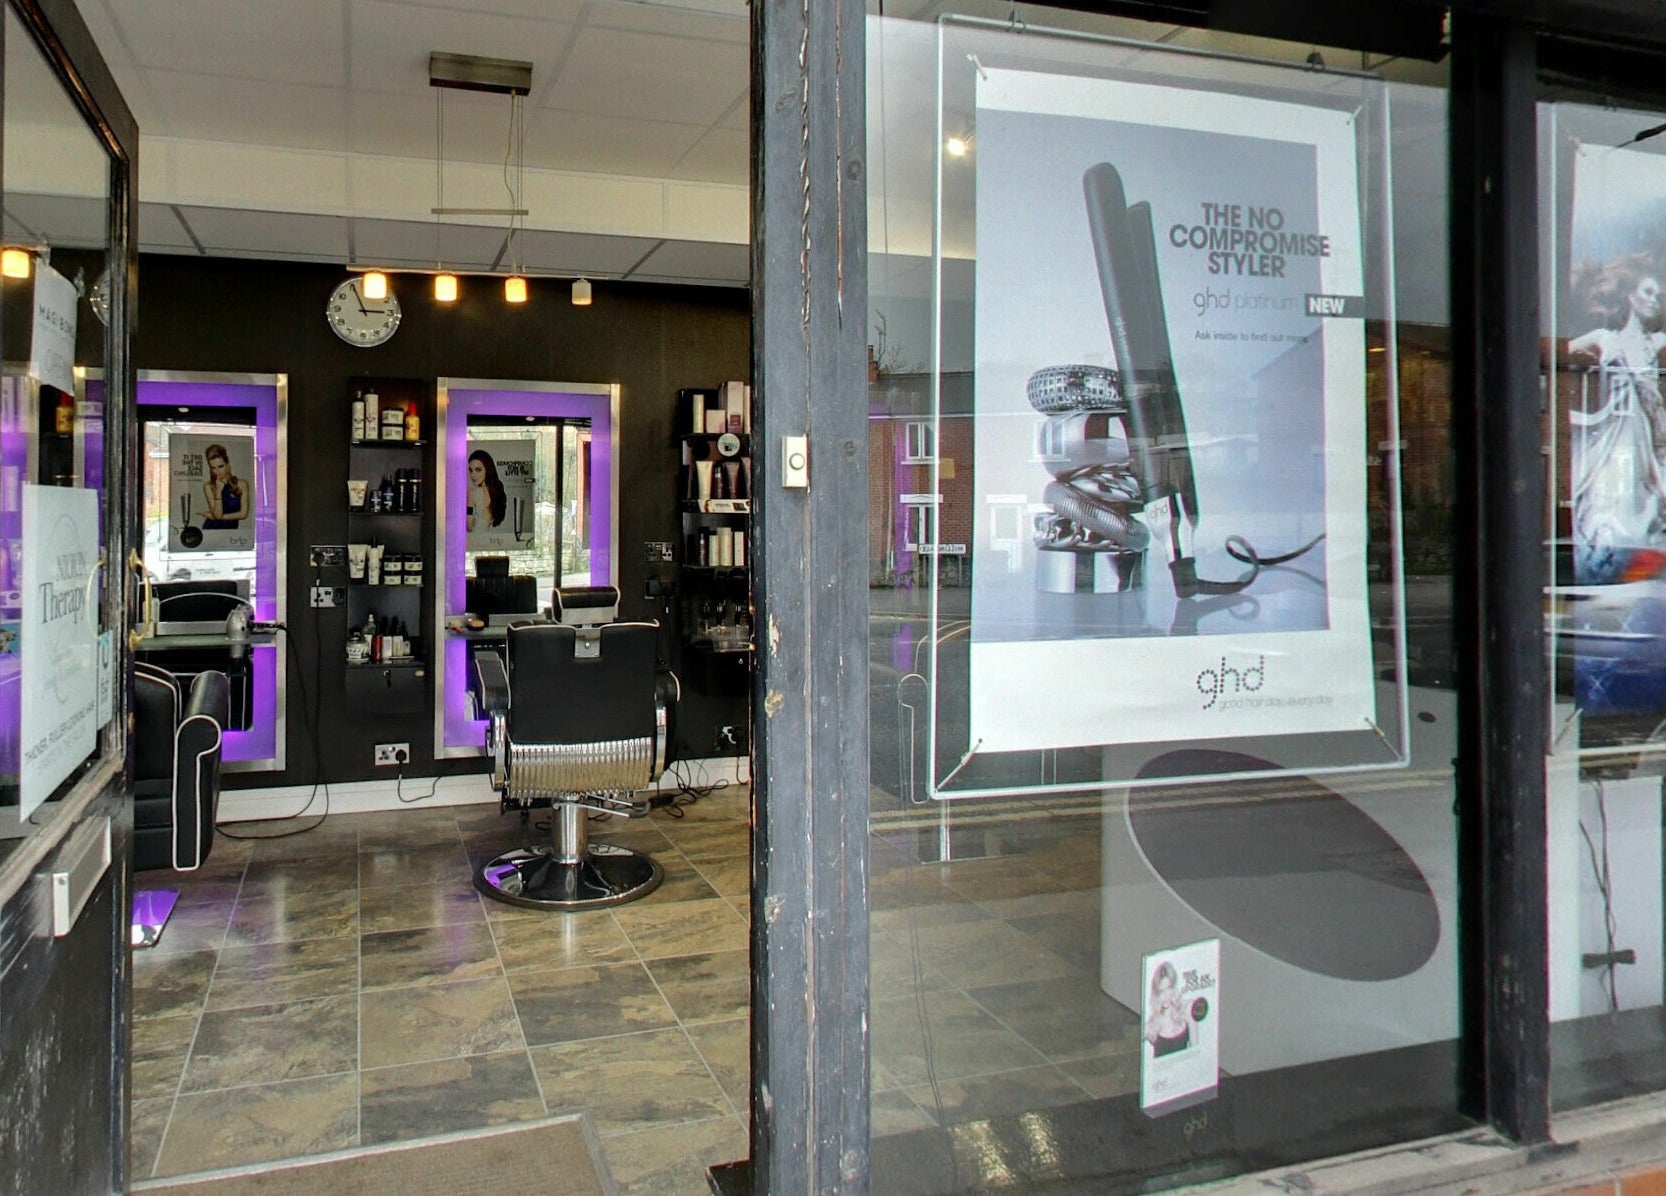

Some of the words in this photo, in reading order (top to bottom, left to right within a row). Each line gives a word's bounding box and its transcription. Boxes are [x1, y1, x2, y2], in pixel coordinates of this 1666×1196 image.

[1202, 202, 1241, 228] THE
[1249, 207, 1285, 231] NO
[1169, 223, 1331, 257] COMPROMISE
[1207, 251, 1286, 279] STYLER
[1193, 286, 1230, 316] ghd
[1308, 297, 1345, 314] NEW
[1194, 329, 1211, 340] Ask
[1239, 331, 1250, 341] to
[39, 581, 87, 625] Therapy
[1197, 655, 1264, 710] ghd
